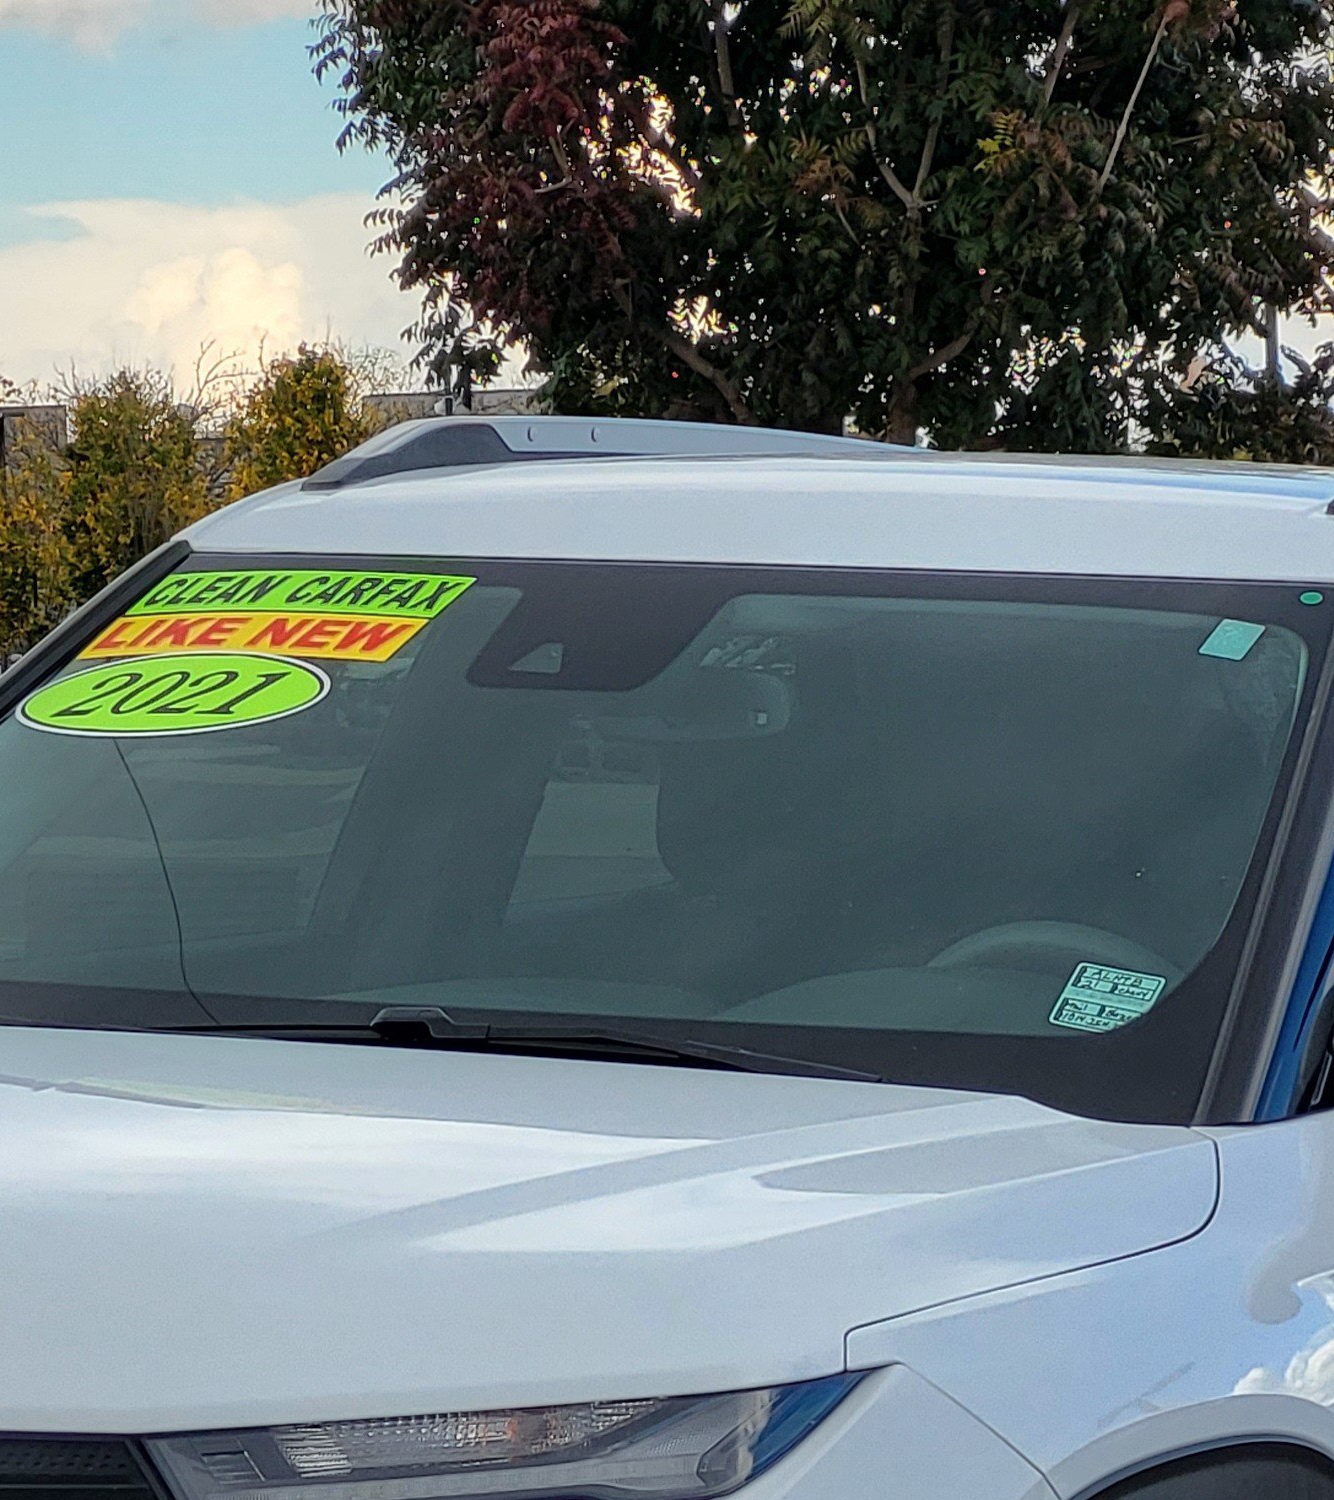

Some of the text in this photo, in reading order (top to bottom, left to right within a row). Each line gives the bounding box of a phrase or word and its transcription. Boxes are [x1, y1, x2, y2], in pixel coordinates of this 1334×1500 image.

[145, 574, 464, 611] CLEAN CARFAX
[92, 617, 413, 653] LIKE NEW
[50, 670, 293, 718] 2021
